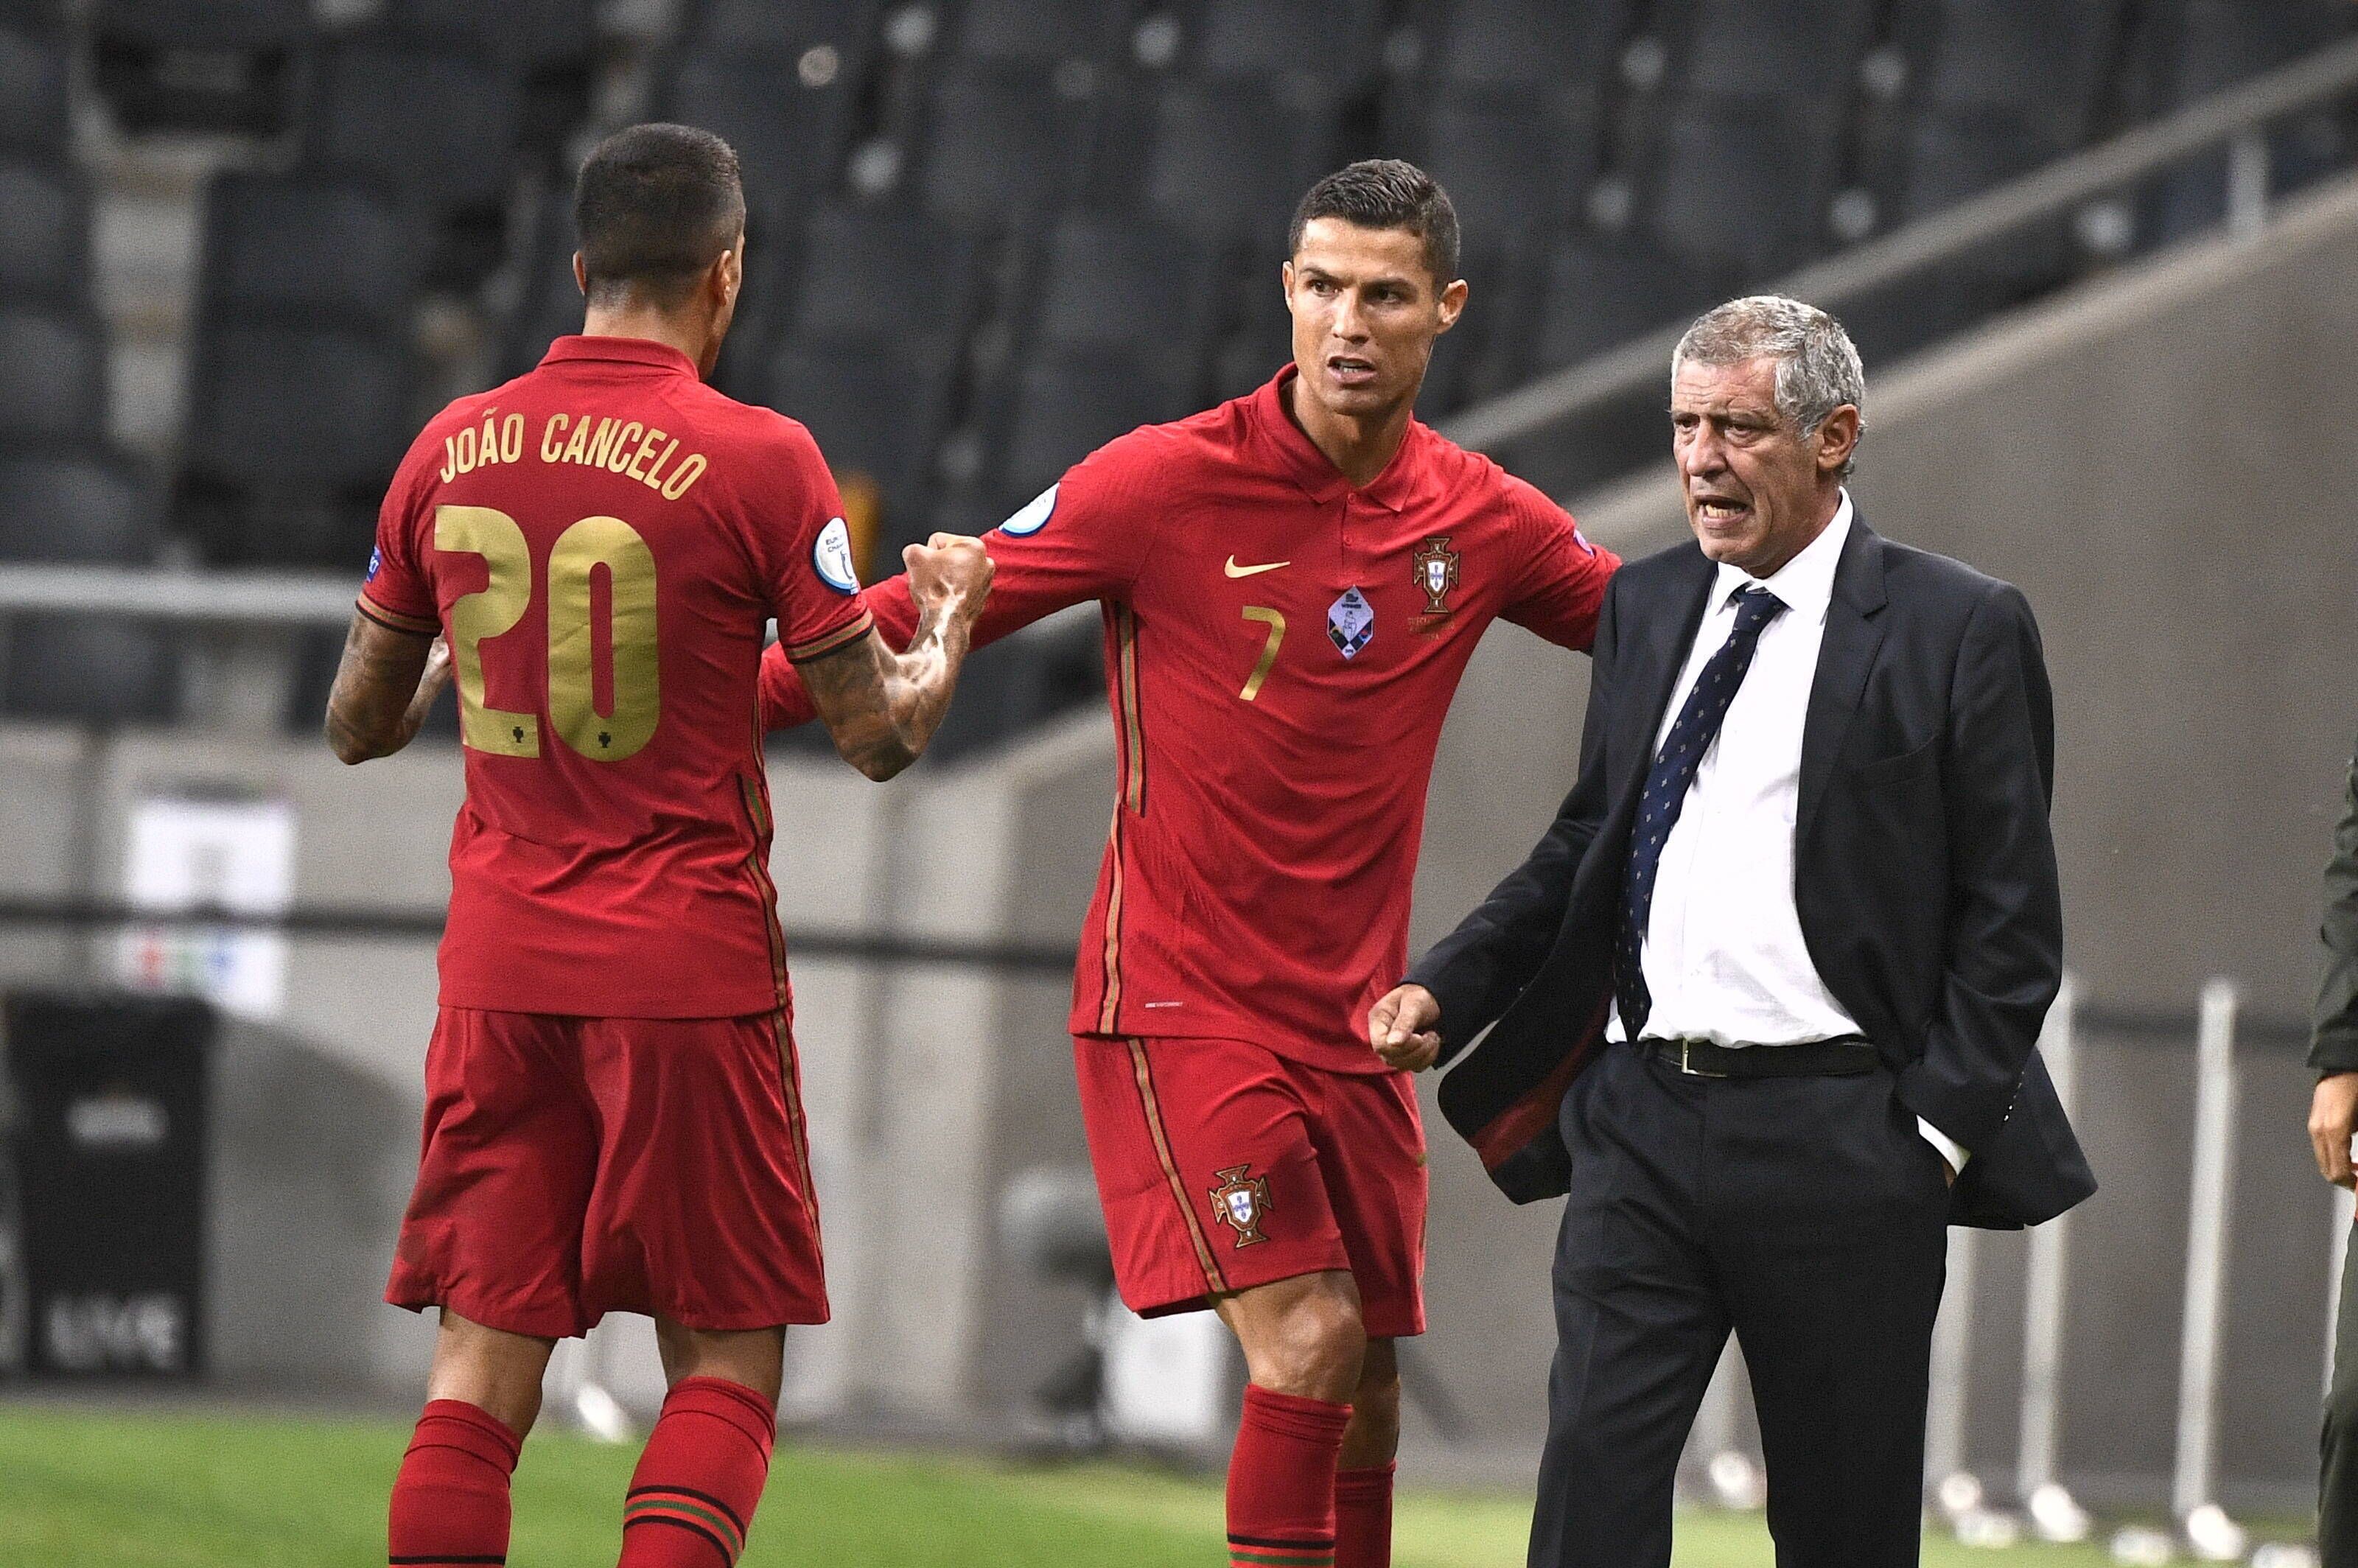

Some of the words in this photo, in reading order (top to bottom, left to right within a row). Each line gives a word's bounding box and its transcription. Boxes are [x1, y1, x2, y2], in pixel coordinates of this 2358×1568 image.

[440, 407, 525, 483] JOÃO
[539, 413, 707, 500] CANCELO
[434, 505, 661, 762] 20
[1239, 605, 1286, 701] 7
